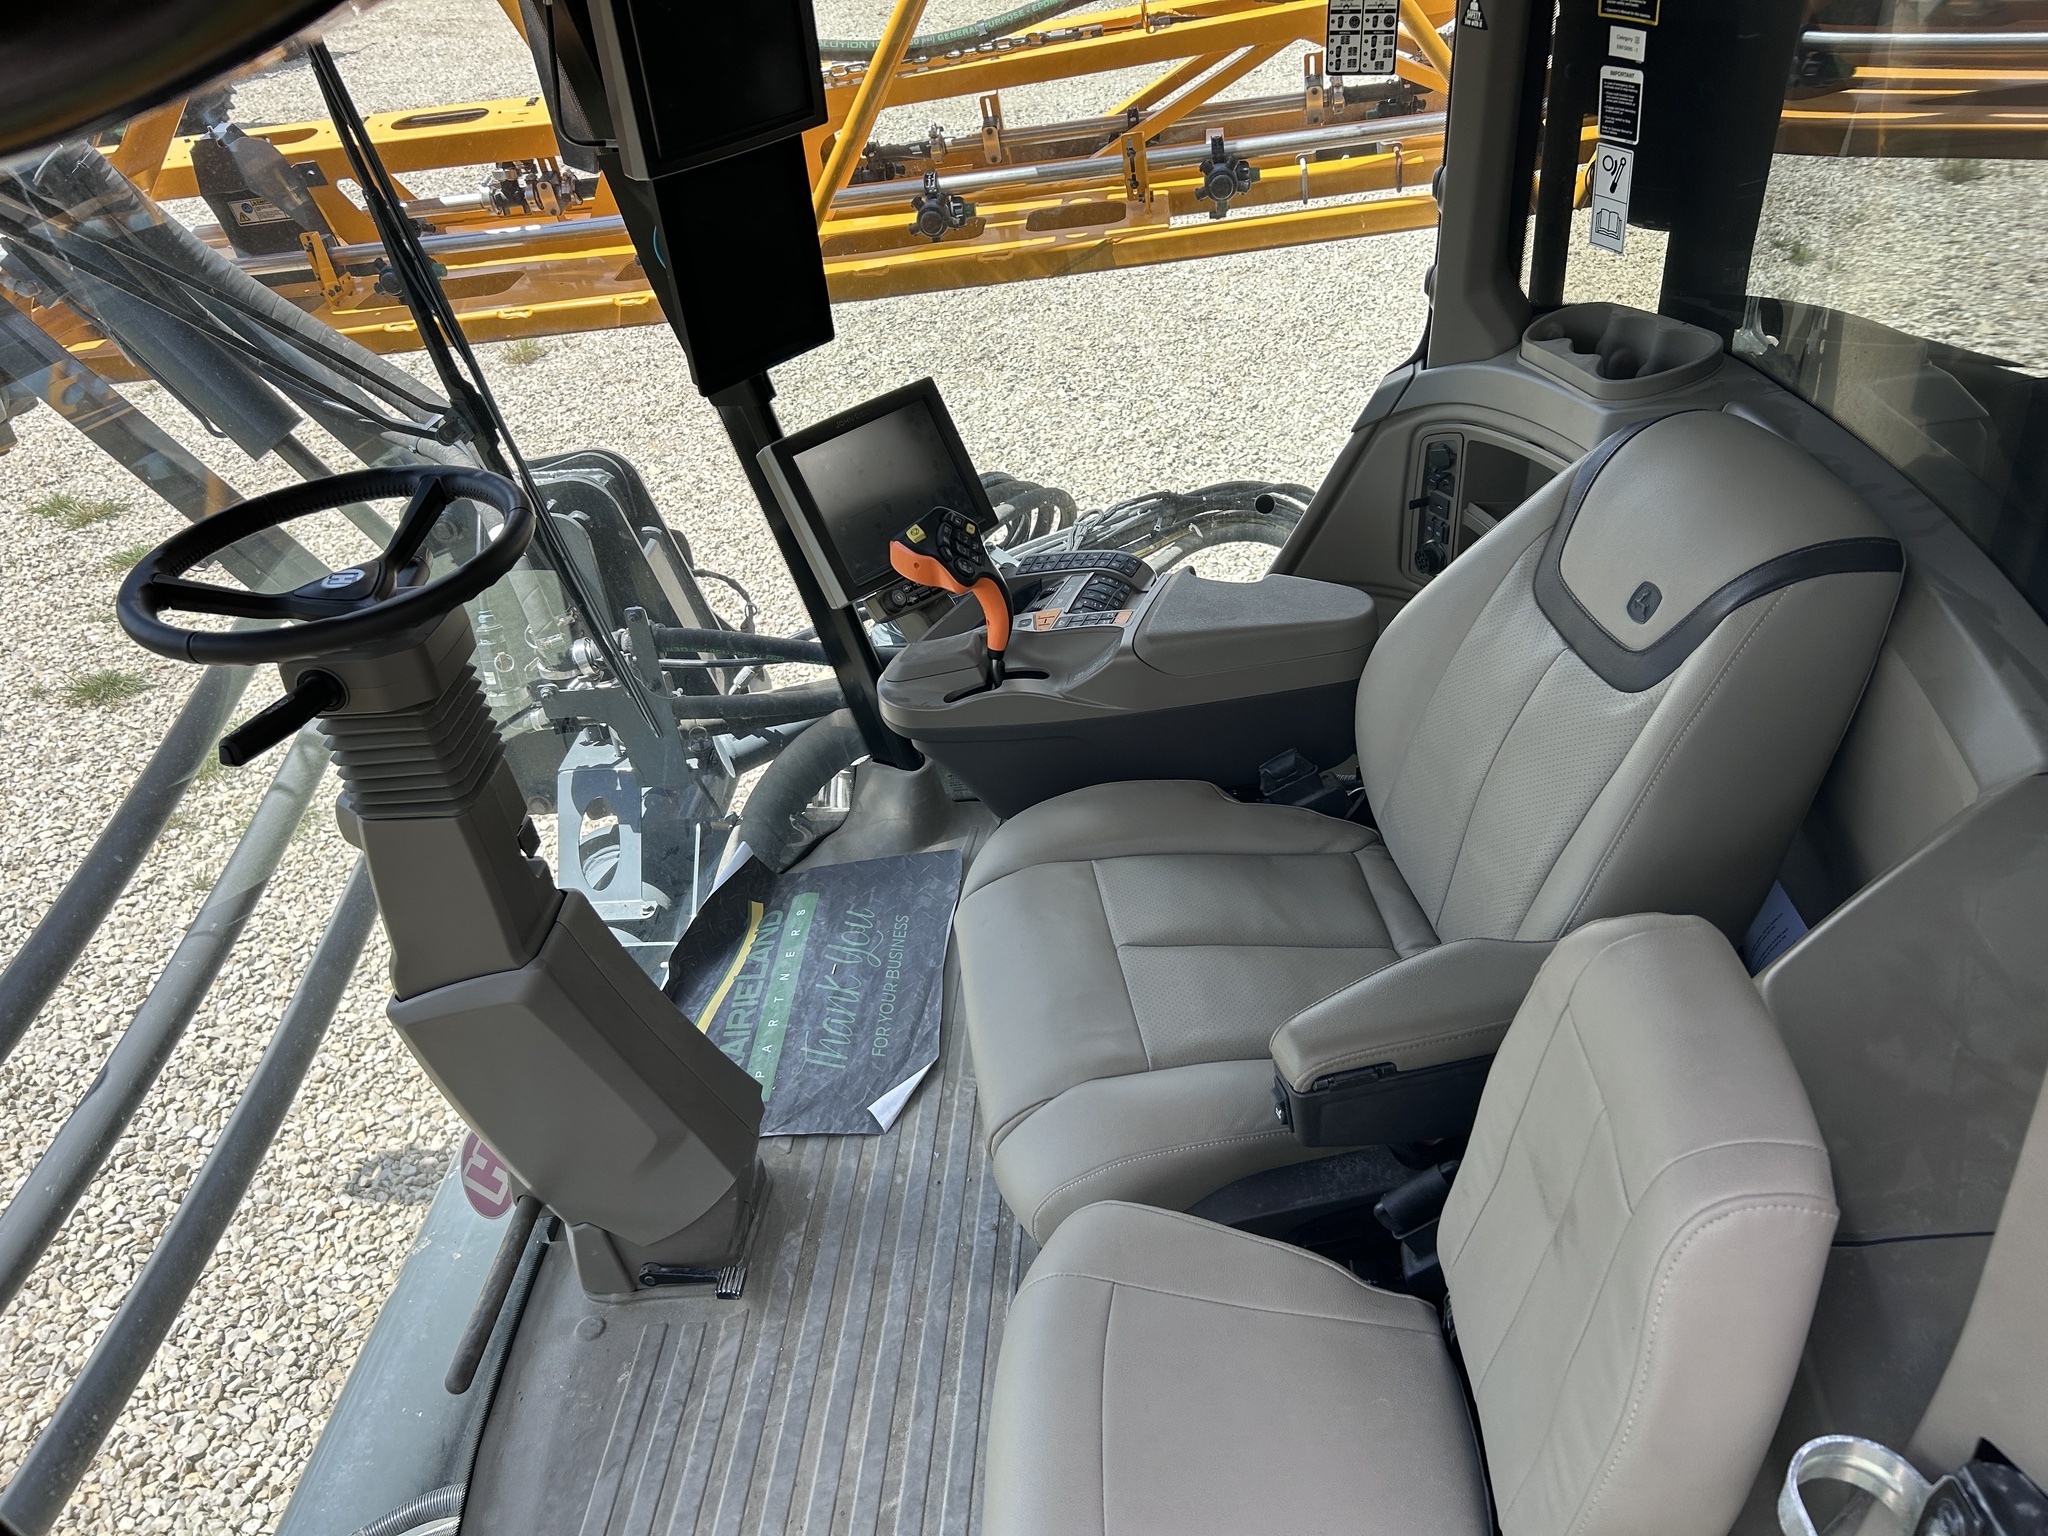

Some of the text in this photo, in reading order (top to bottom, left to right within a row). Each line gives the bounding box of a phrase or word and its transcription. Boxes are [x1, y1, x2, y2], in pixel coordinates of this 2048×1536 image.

[1610, 70, 1635, 78] IMPORTANT
[836, 415, 855, 429] JOHN
[719, 910, 784, 1067] AIRIELAND
[755, 909, 806, 1078] PARTNERS
[872, 914, 909, 1057] FOR YOUR BUSINESS
